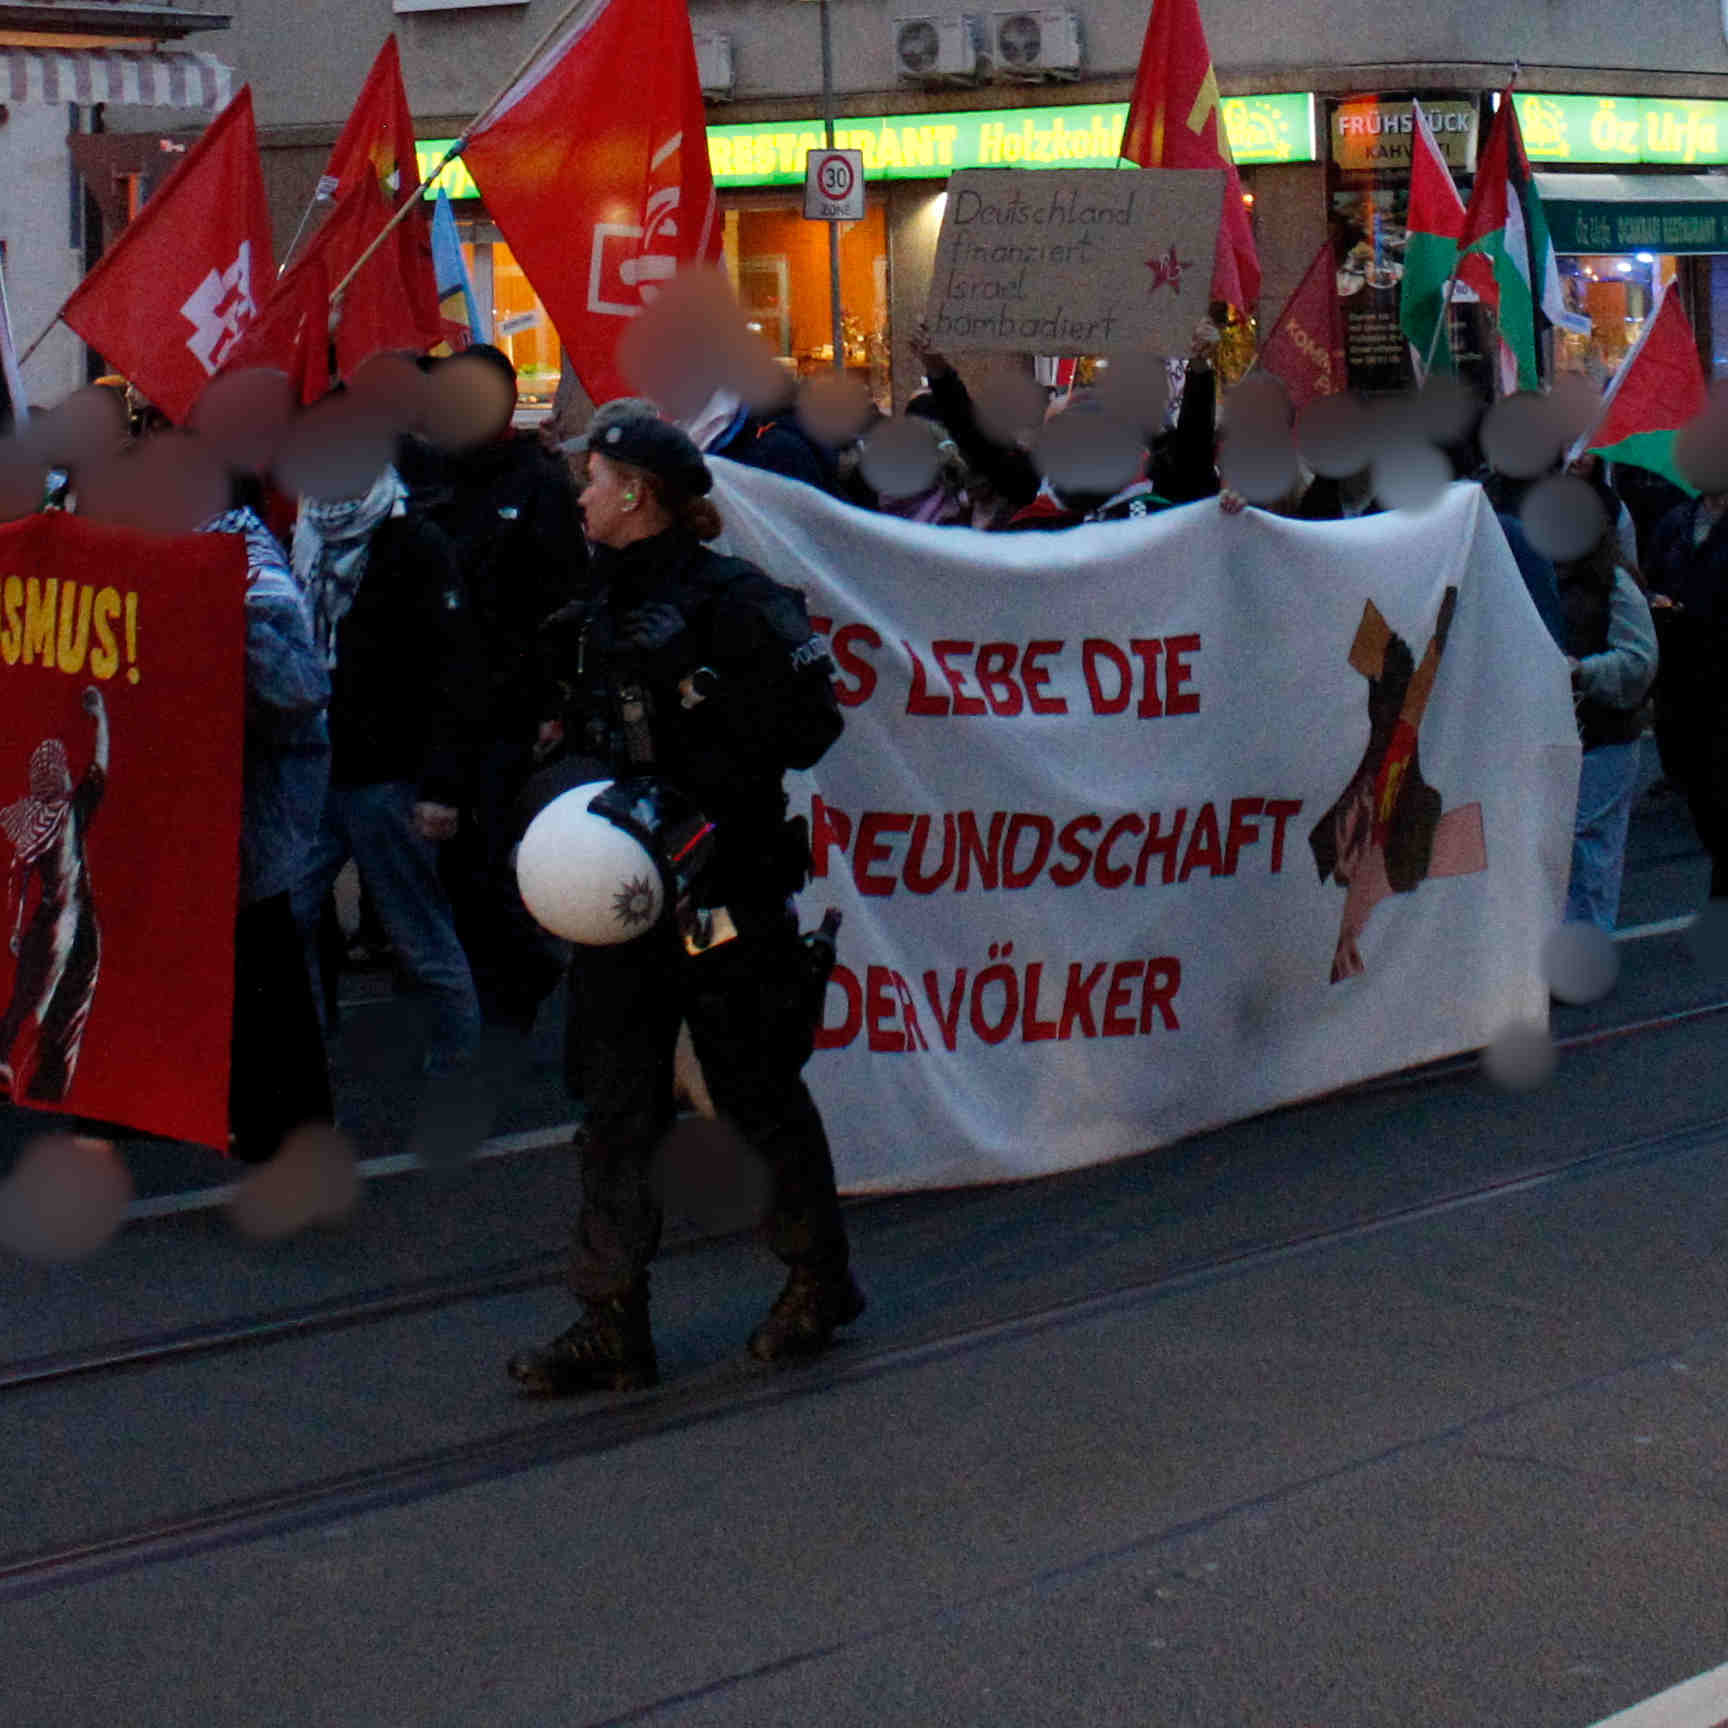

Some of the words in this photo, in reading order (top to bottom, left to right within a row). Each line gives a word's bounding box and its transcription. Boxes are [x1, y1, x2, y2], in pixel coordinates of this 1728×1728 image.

[1338, 109, 1470, 137] FRÜHSÜCK
[825, 167, 848, 189] 30
[808, 615, 883, 708] S
[900, 639, 1069, 717] LEBE
[1081, 633, 1202, 720] DIE
[812, 963, 929, 1053] DER
[922, 941, 1183, 1052] VÖLKER
